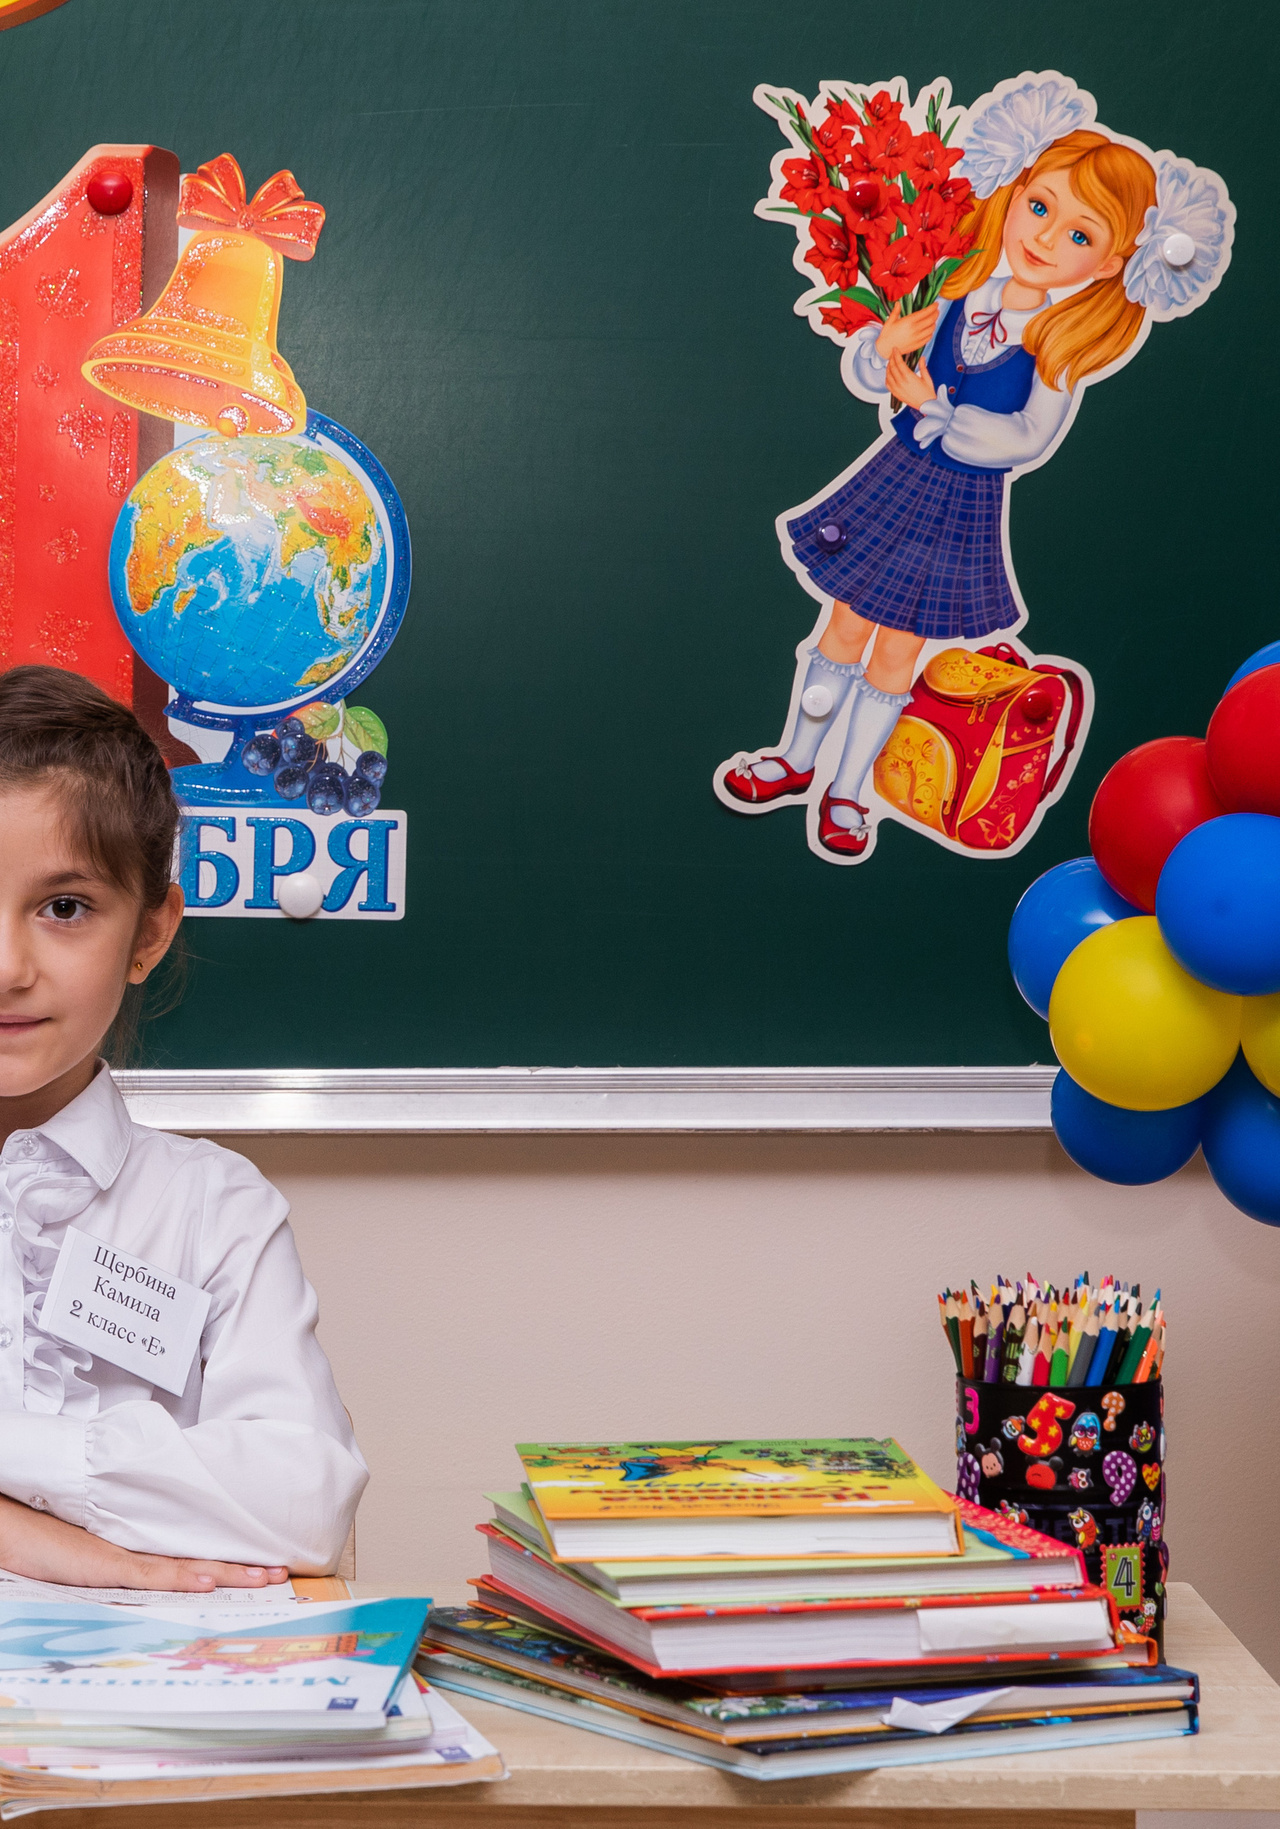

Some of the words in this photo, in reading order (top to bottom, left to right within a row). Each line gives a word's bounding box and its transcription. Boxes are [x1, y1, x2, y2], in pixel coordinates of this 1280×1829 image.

[93, 1245, 177, 1300] Щербина
[93, 1275, 162, 1323] Камила
[70, 1299, 83, 1318] 2
[87, 1311, 137, 1344] класс
[141, 1335, 166, 1357] «Е»
[1017, 1391, 1077, 1458] 5
[1102, 1450, 1138, 1507] 9
[1112, 1556, 1136, 1598] 4
